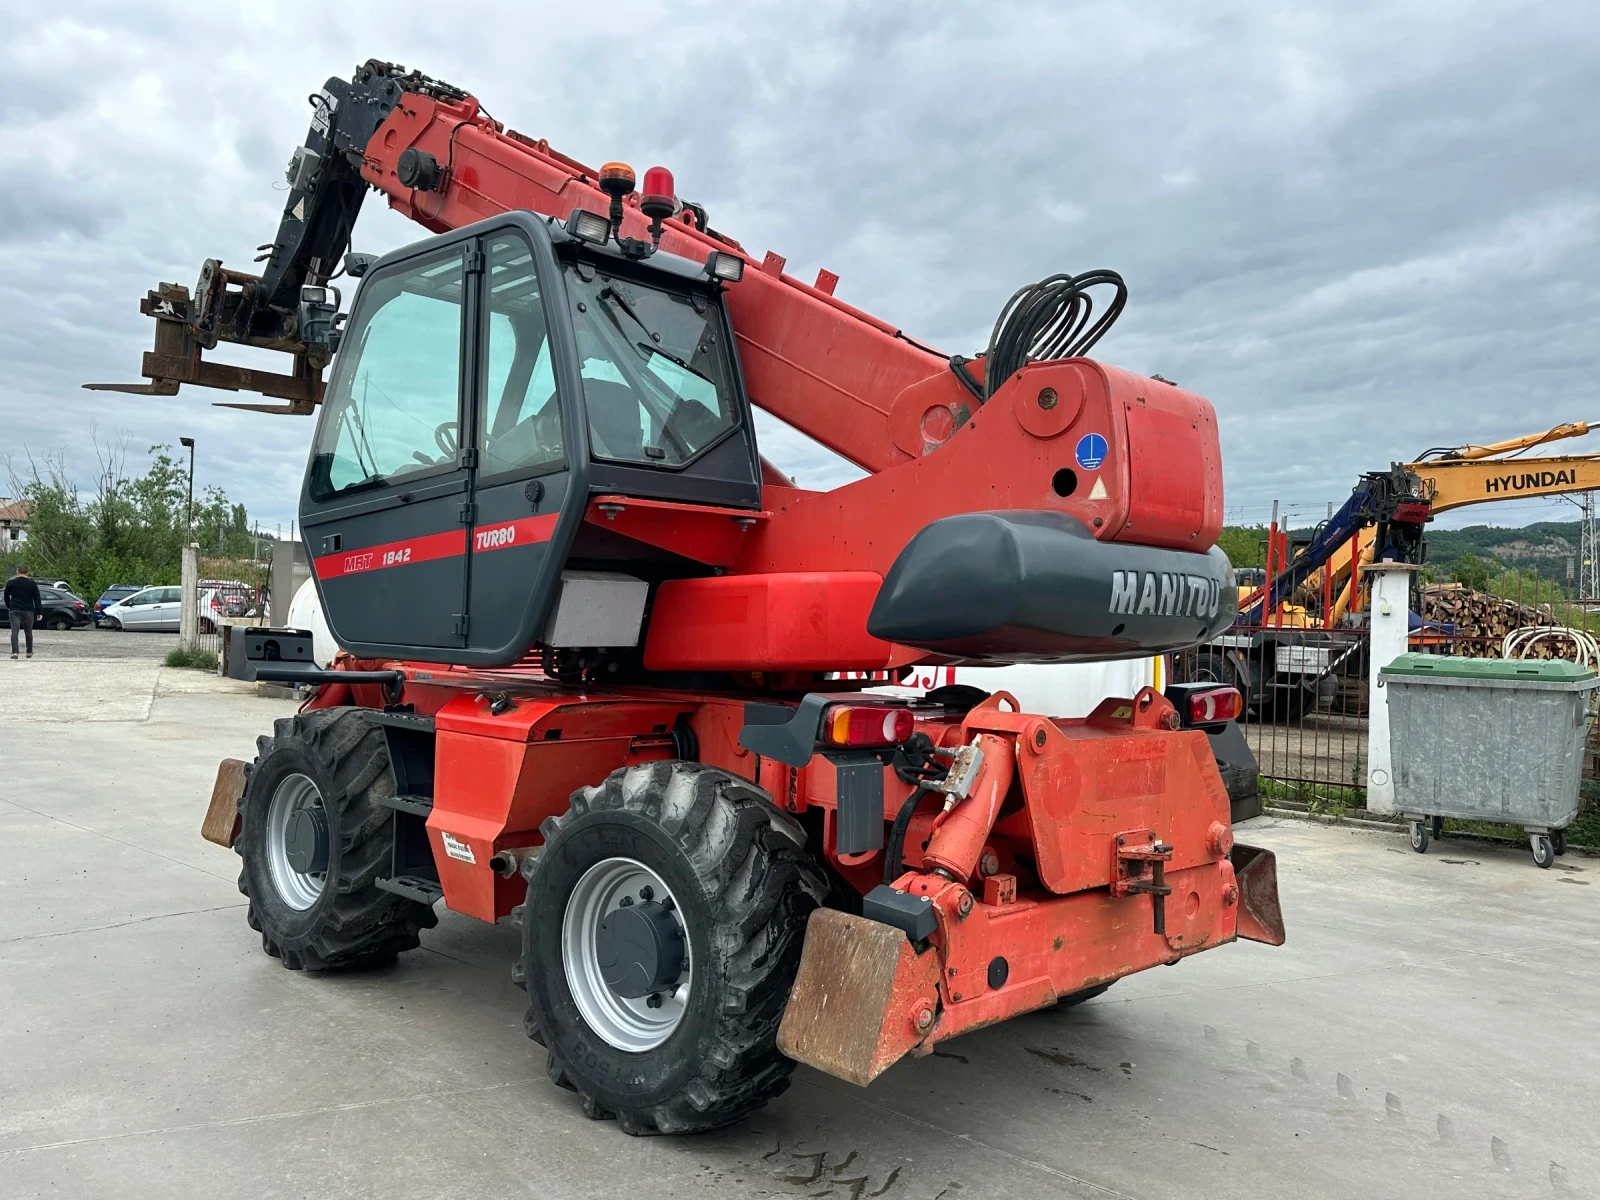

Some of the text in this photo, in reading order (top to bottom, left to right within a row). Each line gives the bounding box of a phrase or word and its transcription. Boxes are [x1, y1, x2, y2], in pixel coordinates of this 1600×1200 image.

[1486, 469, 1576, 492] HYUNDAI
[476, 525, 516, 550] TURBO
[344, 548, 411, 573] MRT 1842
[1108, 570, 1220, 618] MANITOU
